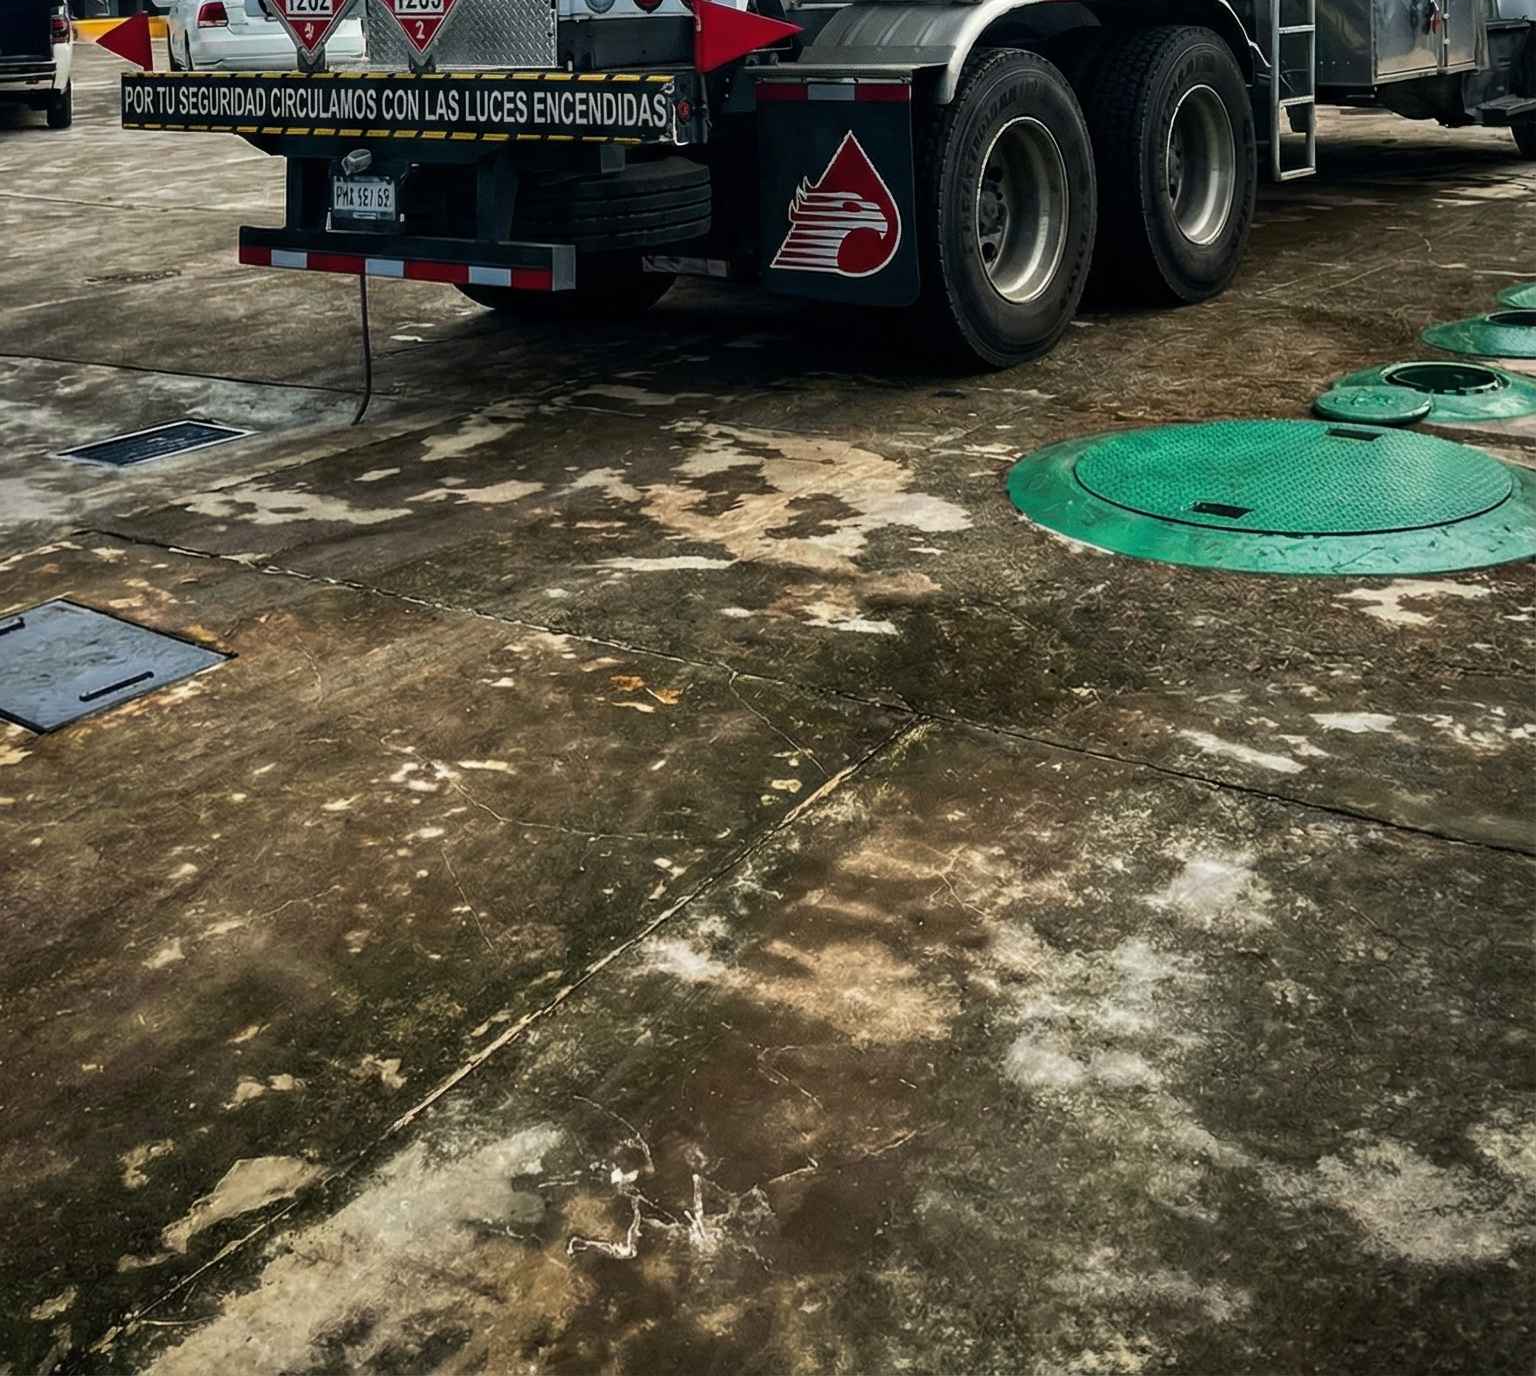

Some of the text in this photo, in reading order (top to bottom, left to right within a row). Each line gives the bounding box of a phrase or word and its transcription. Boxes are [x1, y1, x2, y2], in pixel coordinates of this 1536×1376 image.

[125, 85, 667, 127] POR TU SEGURIDAD CIRCULAMOS CON LAS LUCES ENCENDIDAS
